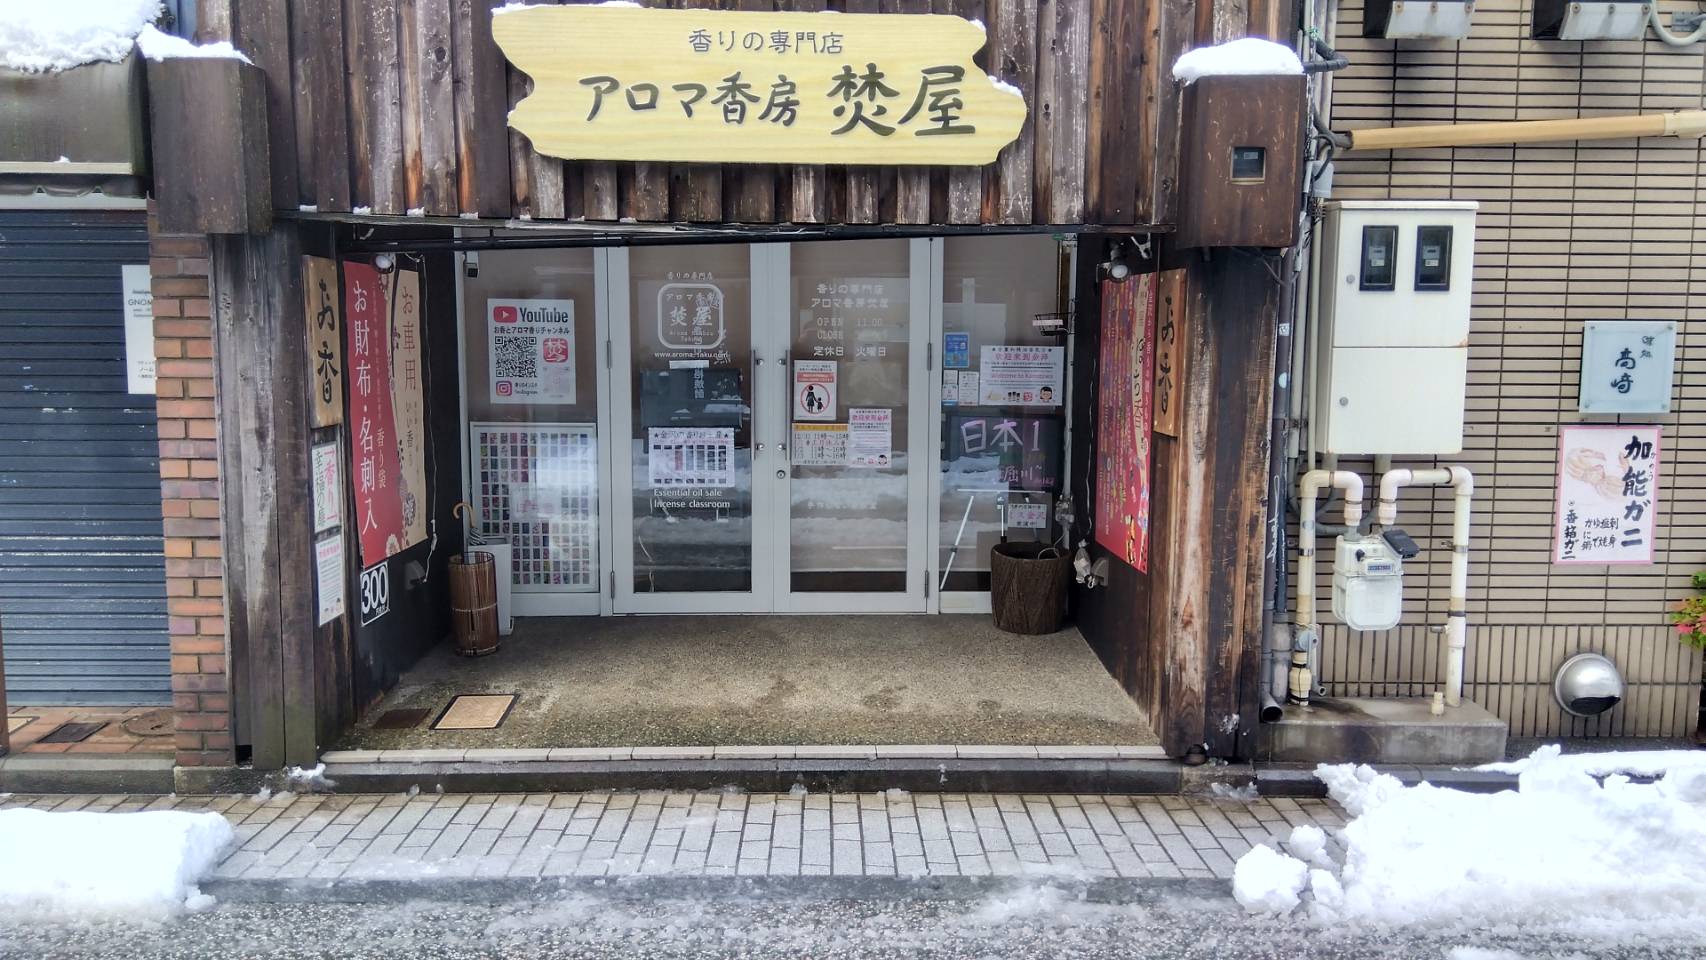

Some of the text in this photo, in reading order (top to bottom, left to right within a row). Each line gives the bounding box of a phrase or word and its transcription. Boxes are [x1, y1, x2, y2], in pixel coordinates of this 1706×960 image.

[689, 29, 843, 55] 香りの専門店
[579, 63, 976, 138] アロマ香房 焚屋
[519, 307, 569, 323] YouTube
[317, 279, 338, 404] お香
[813, 346, 844, 357] 定休日
[1158, 296, 1174, 415] お香
[653, 488, 722, 497] Essential oil sale
[689, 500, 731, 508] classroom
[1620, 435, 1653, 547] 加能ガニ
[361, 566, 388, 614] 300
